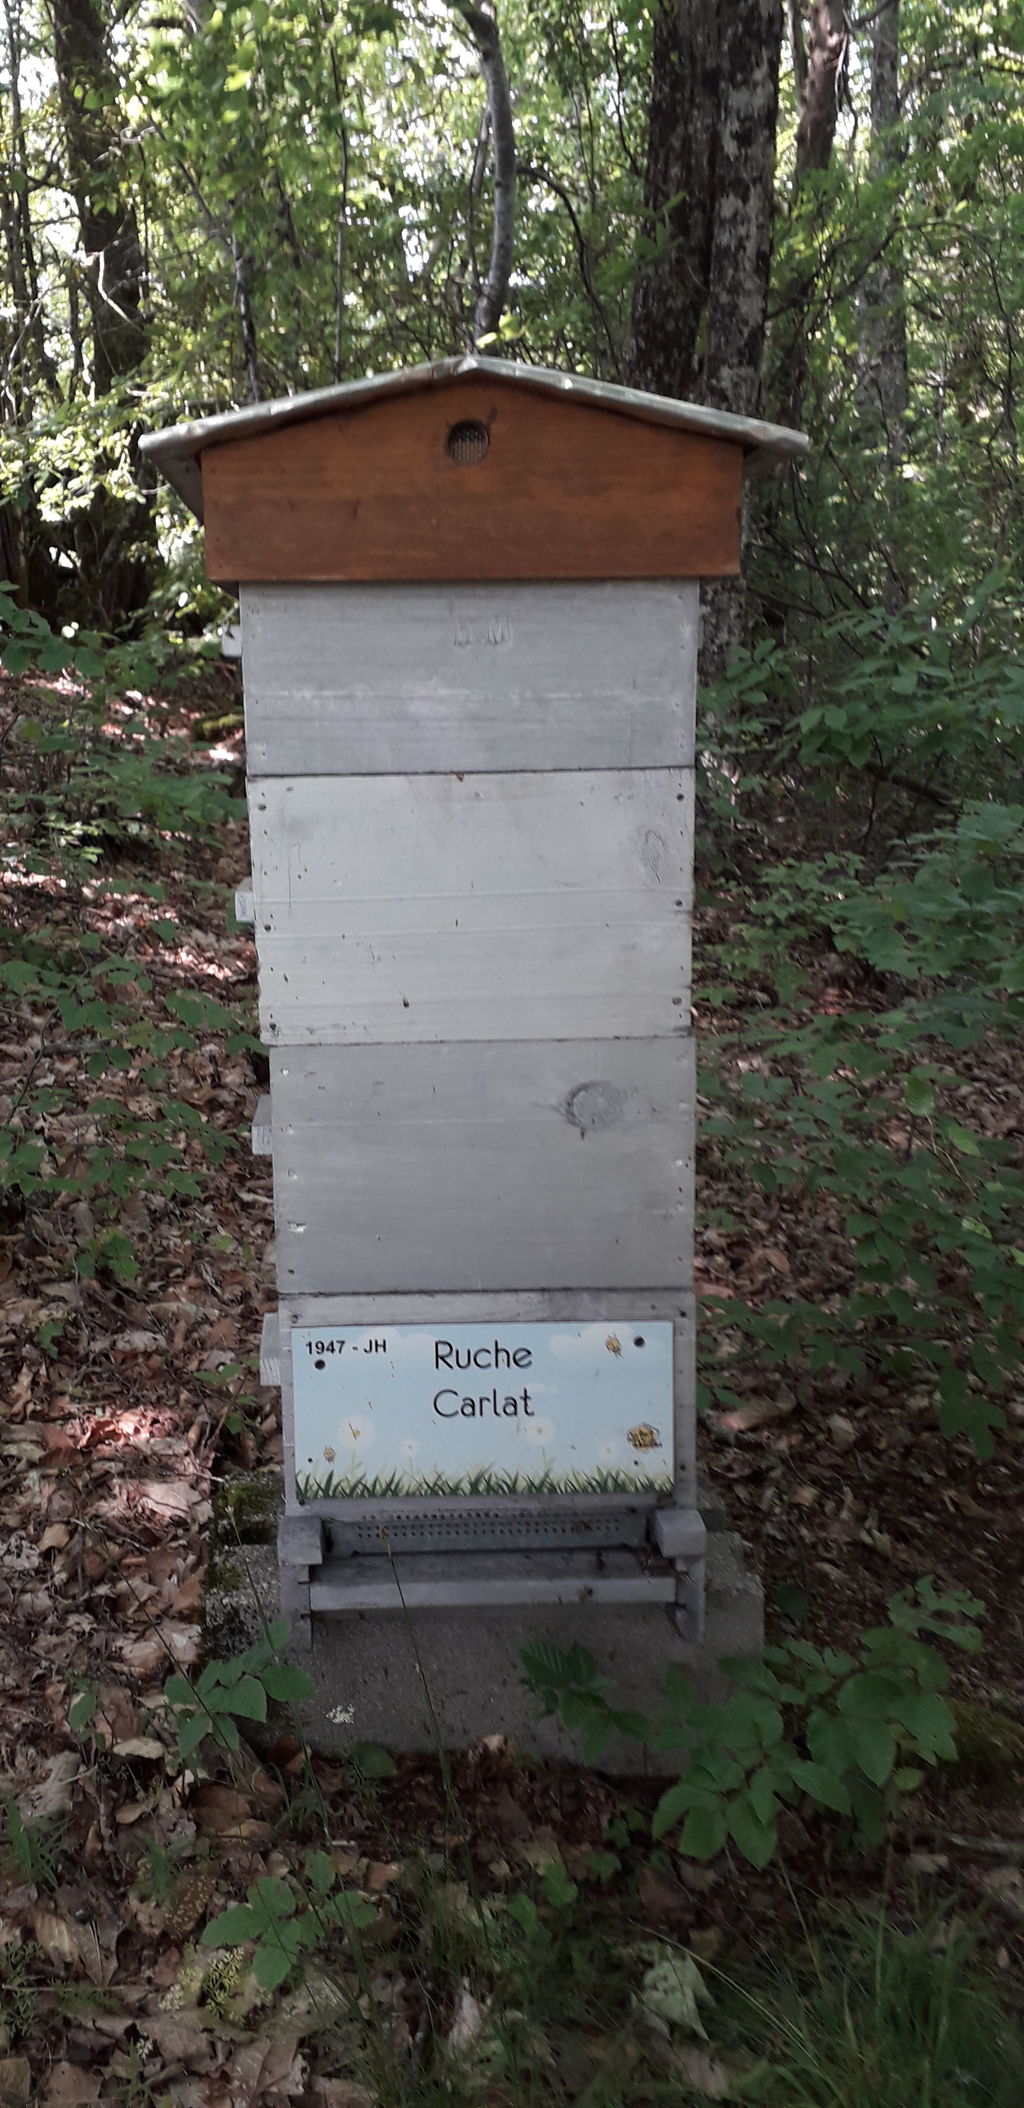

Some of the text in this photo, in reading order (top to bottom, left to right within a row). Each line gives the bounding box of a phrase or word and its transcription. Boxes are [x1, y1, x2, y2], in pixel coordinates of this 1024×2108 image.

[305, 1340, 347, 1355] 1947
[363, 1338, 387, 1354] JH
[434, 1339, 533, 1370] Ruche
[433, 1387, 535, 1418] Carlat
